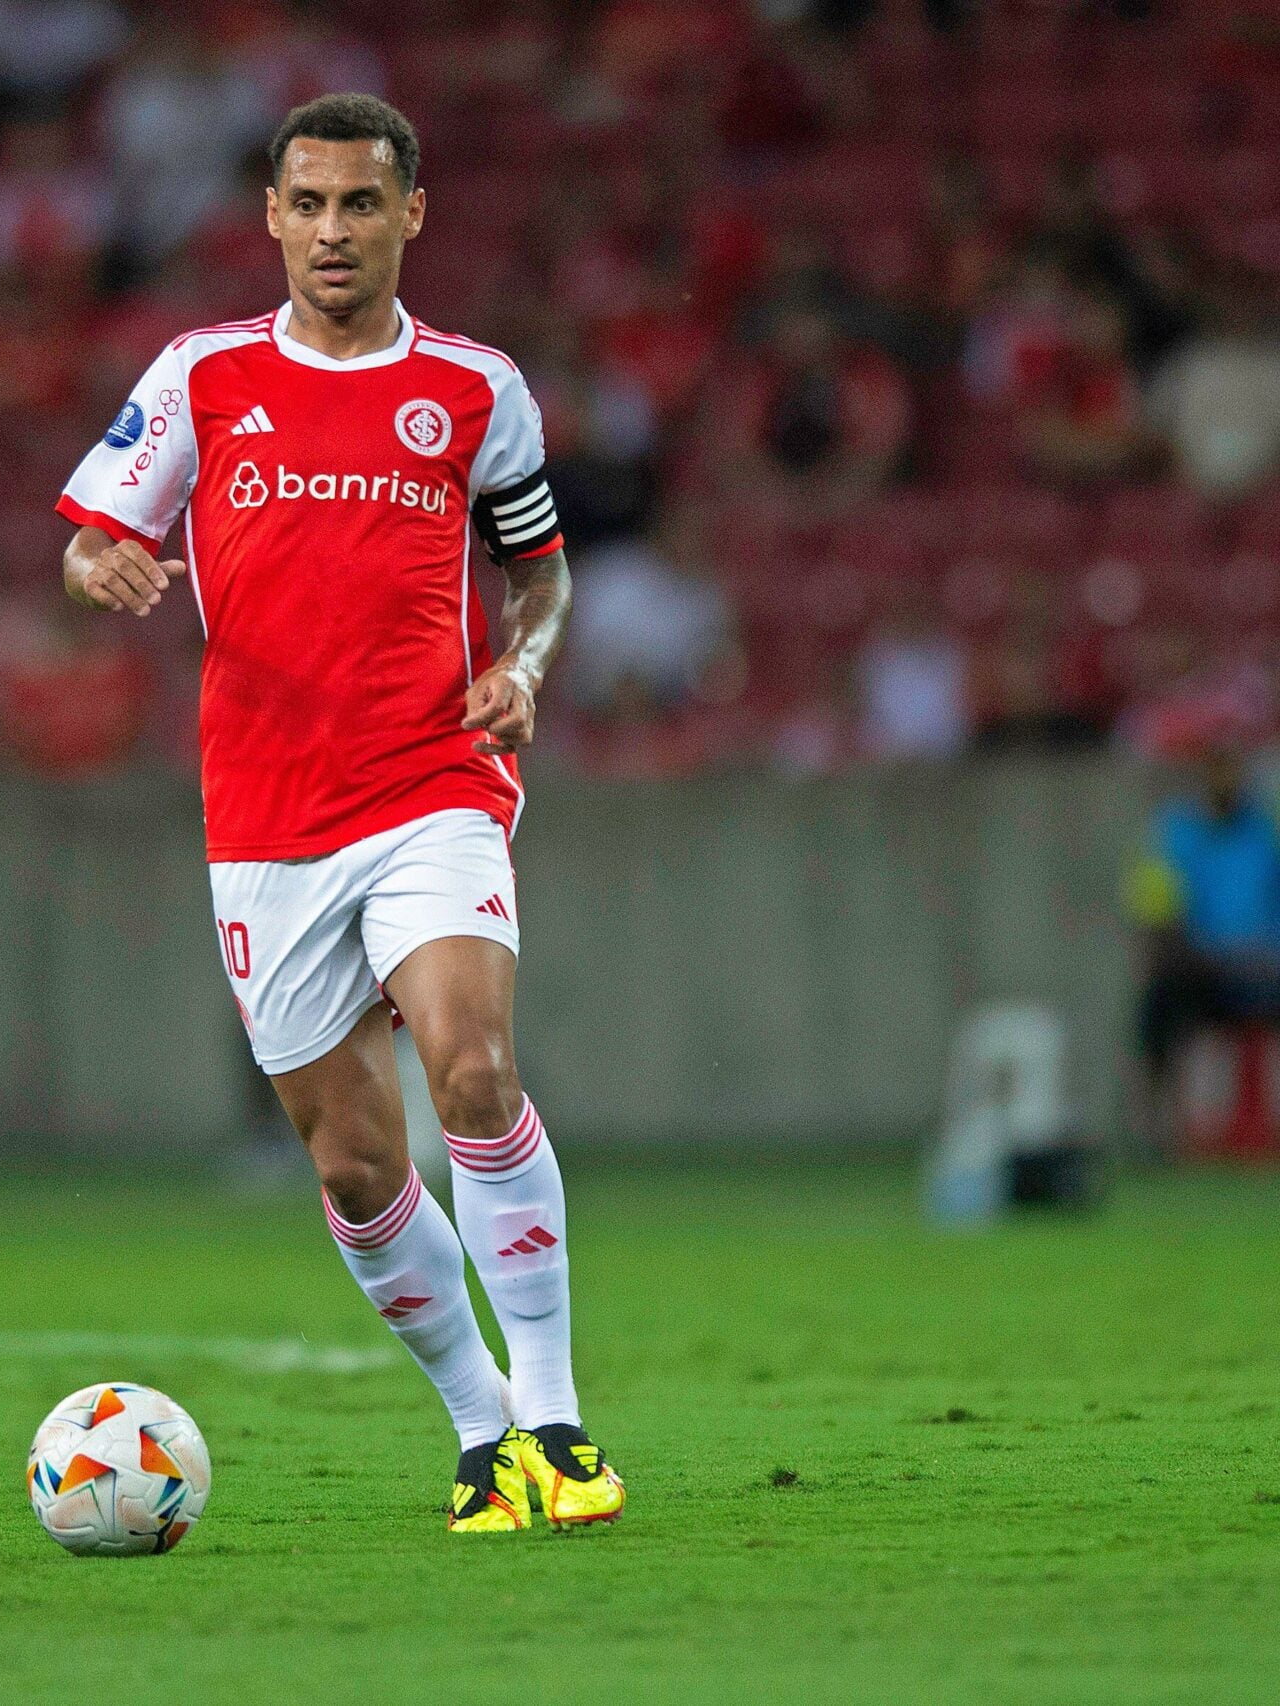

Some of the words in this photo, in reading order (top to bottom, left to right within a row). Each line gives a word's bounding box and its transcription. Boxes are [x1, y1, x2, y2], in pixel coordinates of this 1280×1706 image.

[120, 415, 167, 487] vero
[277, 464, 448, 516] banrisul
[218, 918, 251, 979] 10
